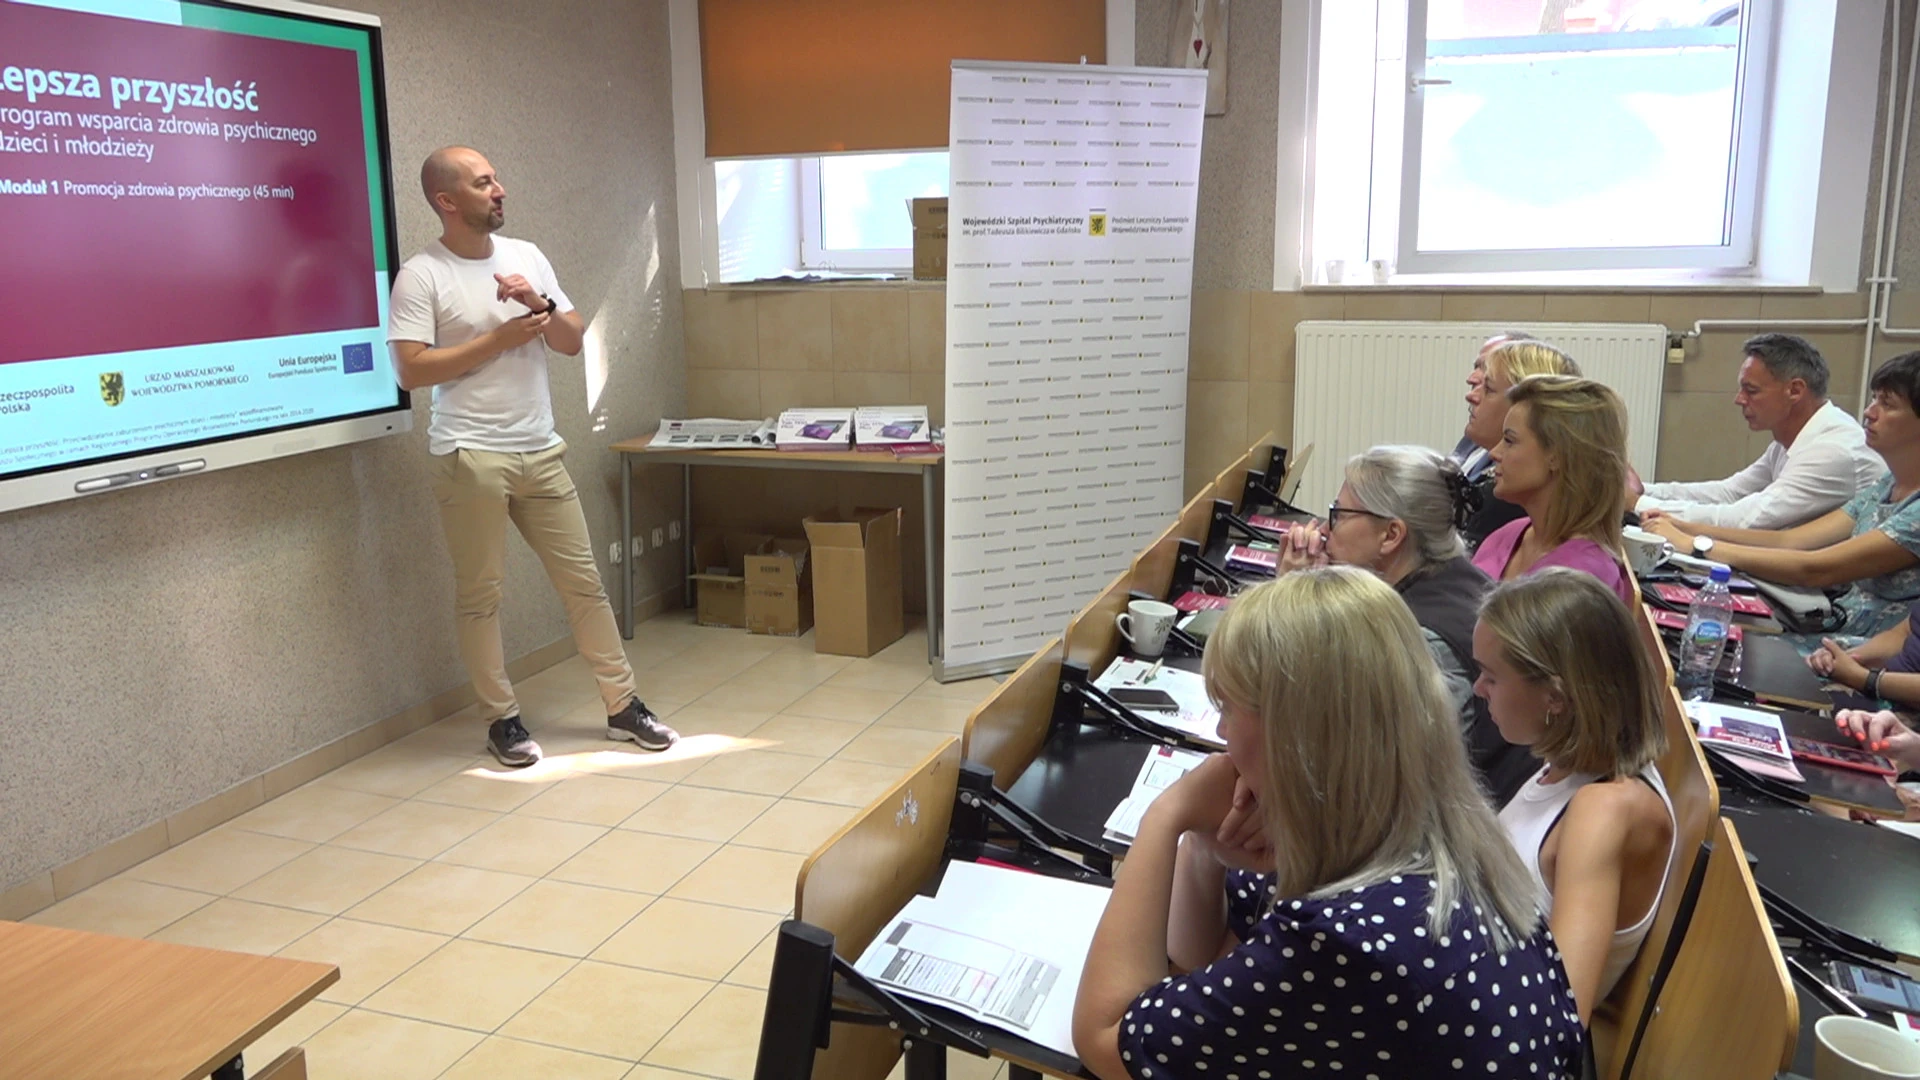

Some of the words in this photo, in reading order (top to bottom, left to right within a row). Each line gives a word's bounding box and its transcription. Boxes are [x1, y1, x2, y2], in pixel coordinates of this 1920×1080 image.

[0, 66, 101, 103] epsza
[111, 76, 259, 113] przyszłość
[0, 107, 72, 131] rogram
[77, 112, 153, 135] wsparcia
[158, 115, 219, 137] zdrowia
[224, 120, 317, 146] psychicznego
[53, 133, 59, 153] i
[65, 135, 154, 163] młodzieży
[0, 179, 47, 195] Moduł
[51, 180, 59, 195] 1
[64, 180, 125, 200] Promocja
[128, 182, 175, 197] zdrowia
[178, 183, 251, 201] psychicznego
[253, 185, 269, 200] (45
[271, 185, 295, 200] min)
[962, 216, 1006, 227] Wojewódzki
[1007, 216, 1031, 227] Szpital
[1032, 215, 1084, 226] Psychiatryczny
[279, 356, 296, 368] Unia
[297, 351, 337, 366] Europejska
[0, 384, 75, 402] zeczpospolita
[0, 402, 31, 415] olska
